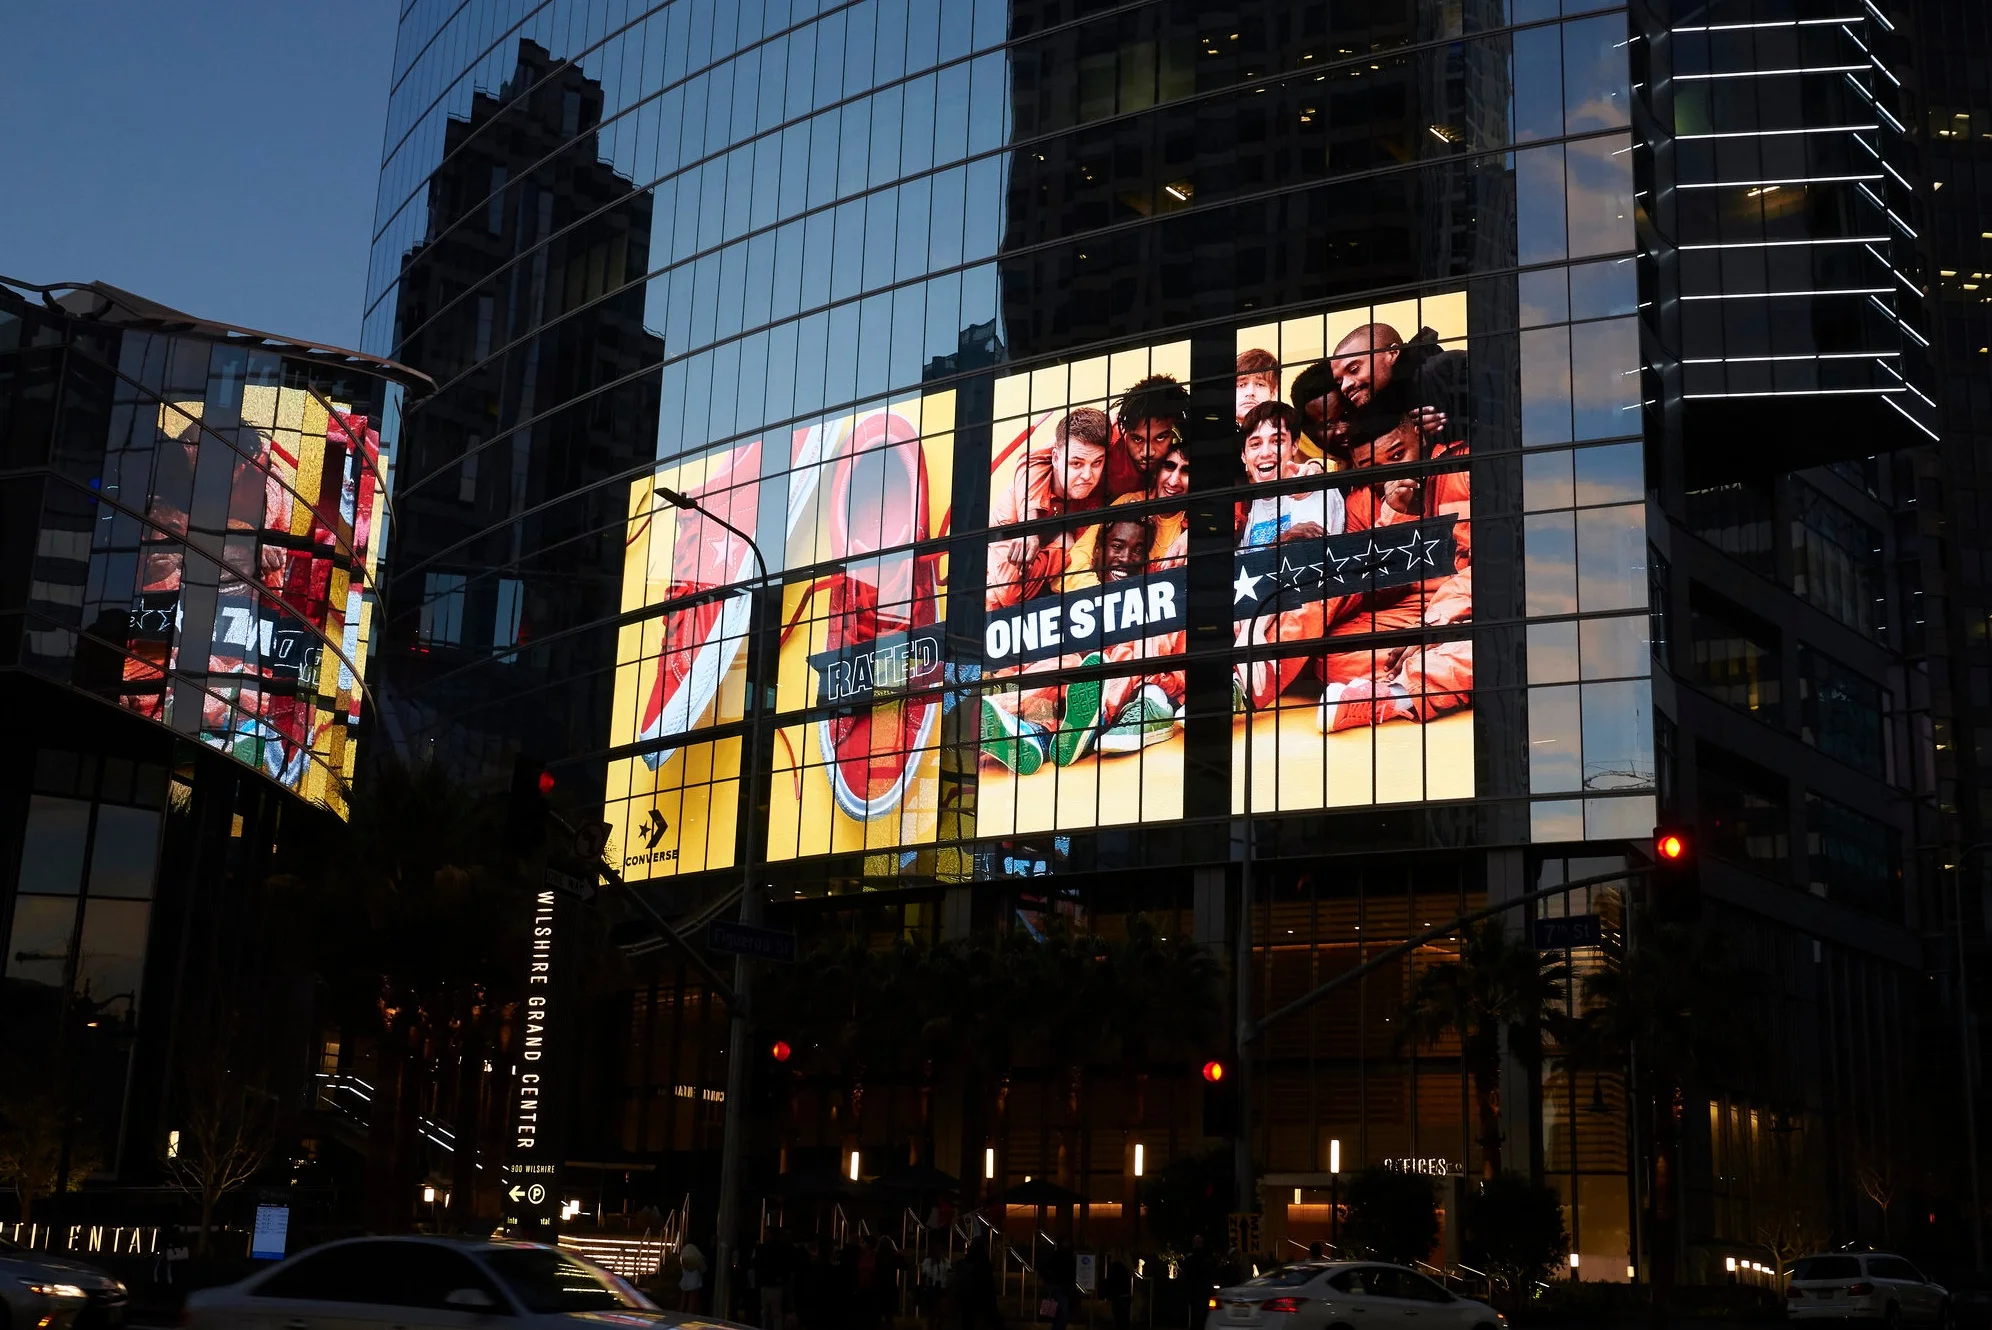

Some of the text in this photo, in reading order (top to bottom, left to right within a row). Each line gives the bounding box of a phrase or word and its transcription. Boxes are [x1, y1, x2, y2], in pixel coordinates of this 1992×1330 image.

[986, 580, 1177, 659] ONE STAR
[827, 636, 938, 700] RATED
[625, 849, 679, 867] CONVERSE
[1573, 924, 1590, 940] St
[516, 890, 555, 1149] WILSHIRE GRAND CENTER
[525, 1164, 555, 1174] WILSHIRE
